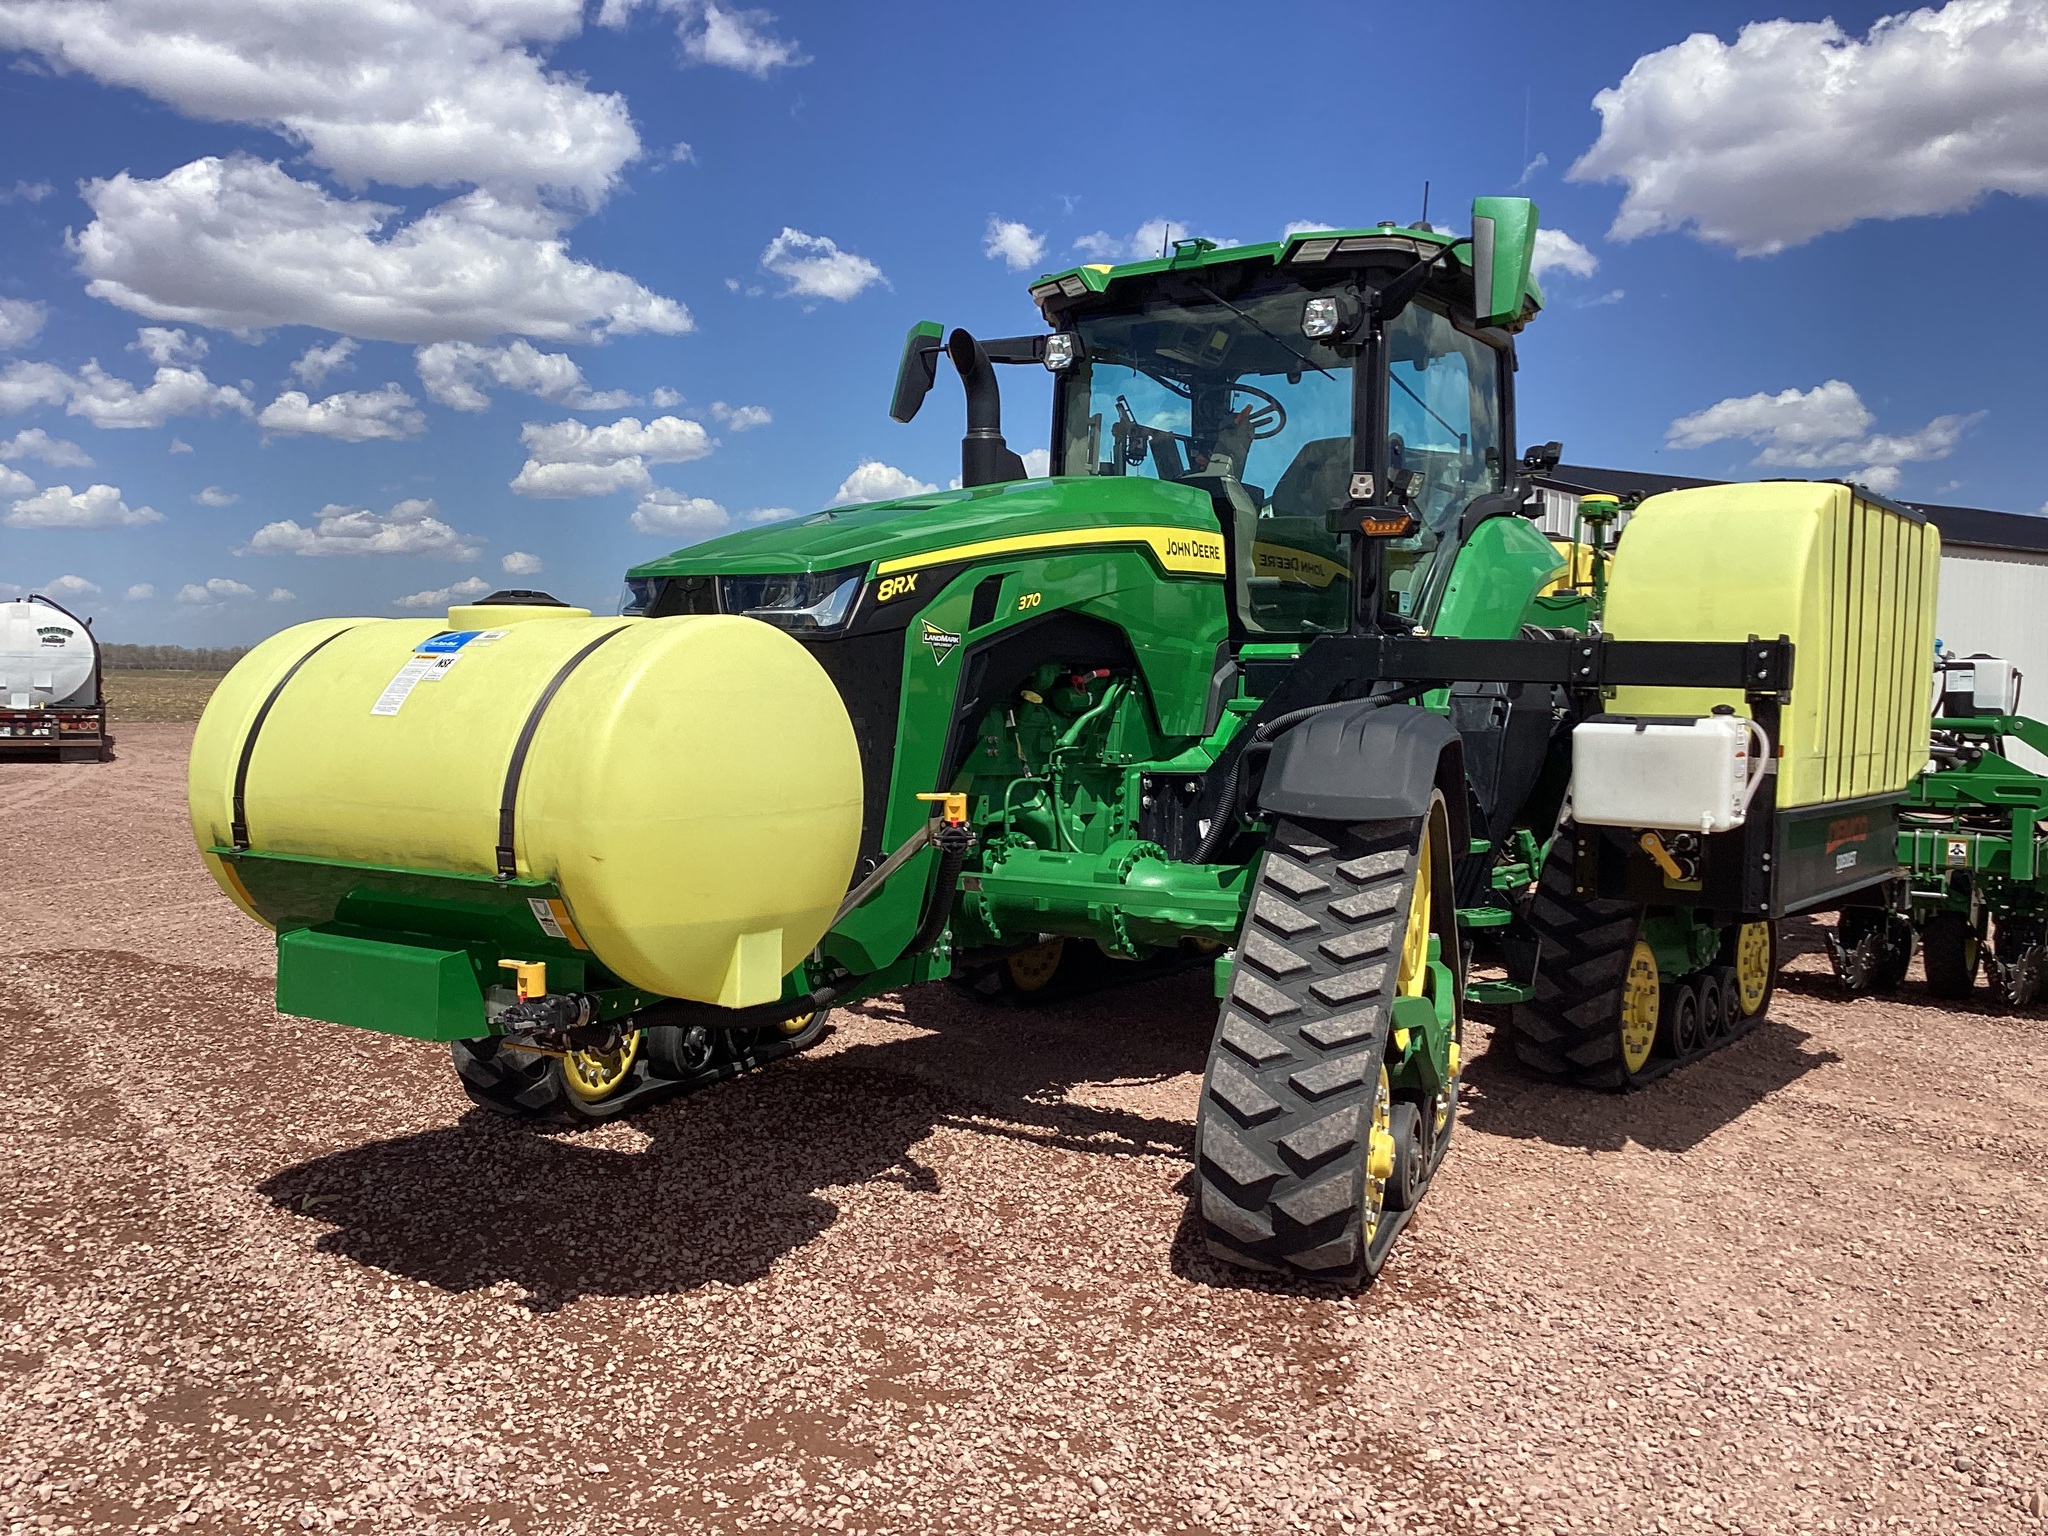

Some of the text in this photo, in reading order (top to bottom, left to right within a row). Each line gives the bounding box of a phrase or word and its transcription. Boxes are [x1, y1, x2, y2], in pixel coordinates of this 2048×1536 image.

[1166, 537, 1220, 560] JOHN DEERE
[877, 573, 919, 601] 8RX
[1018, 592, 1041, 610] 370
[36, 626, 74, 638] ROEDER
